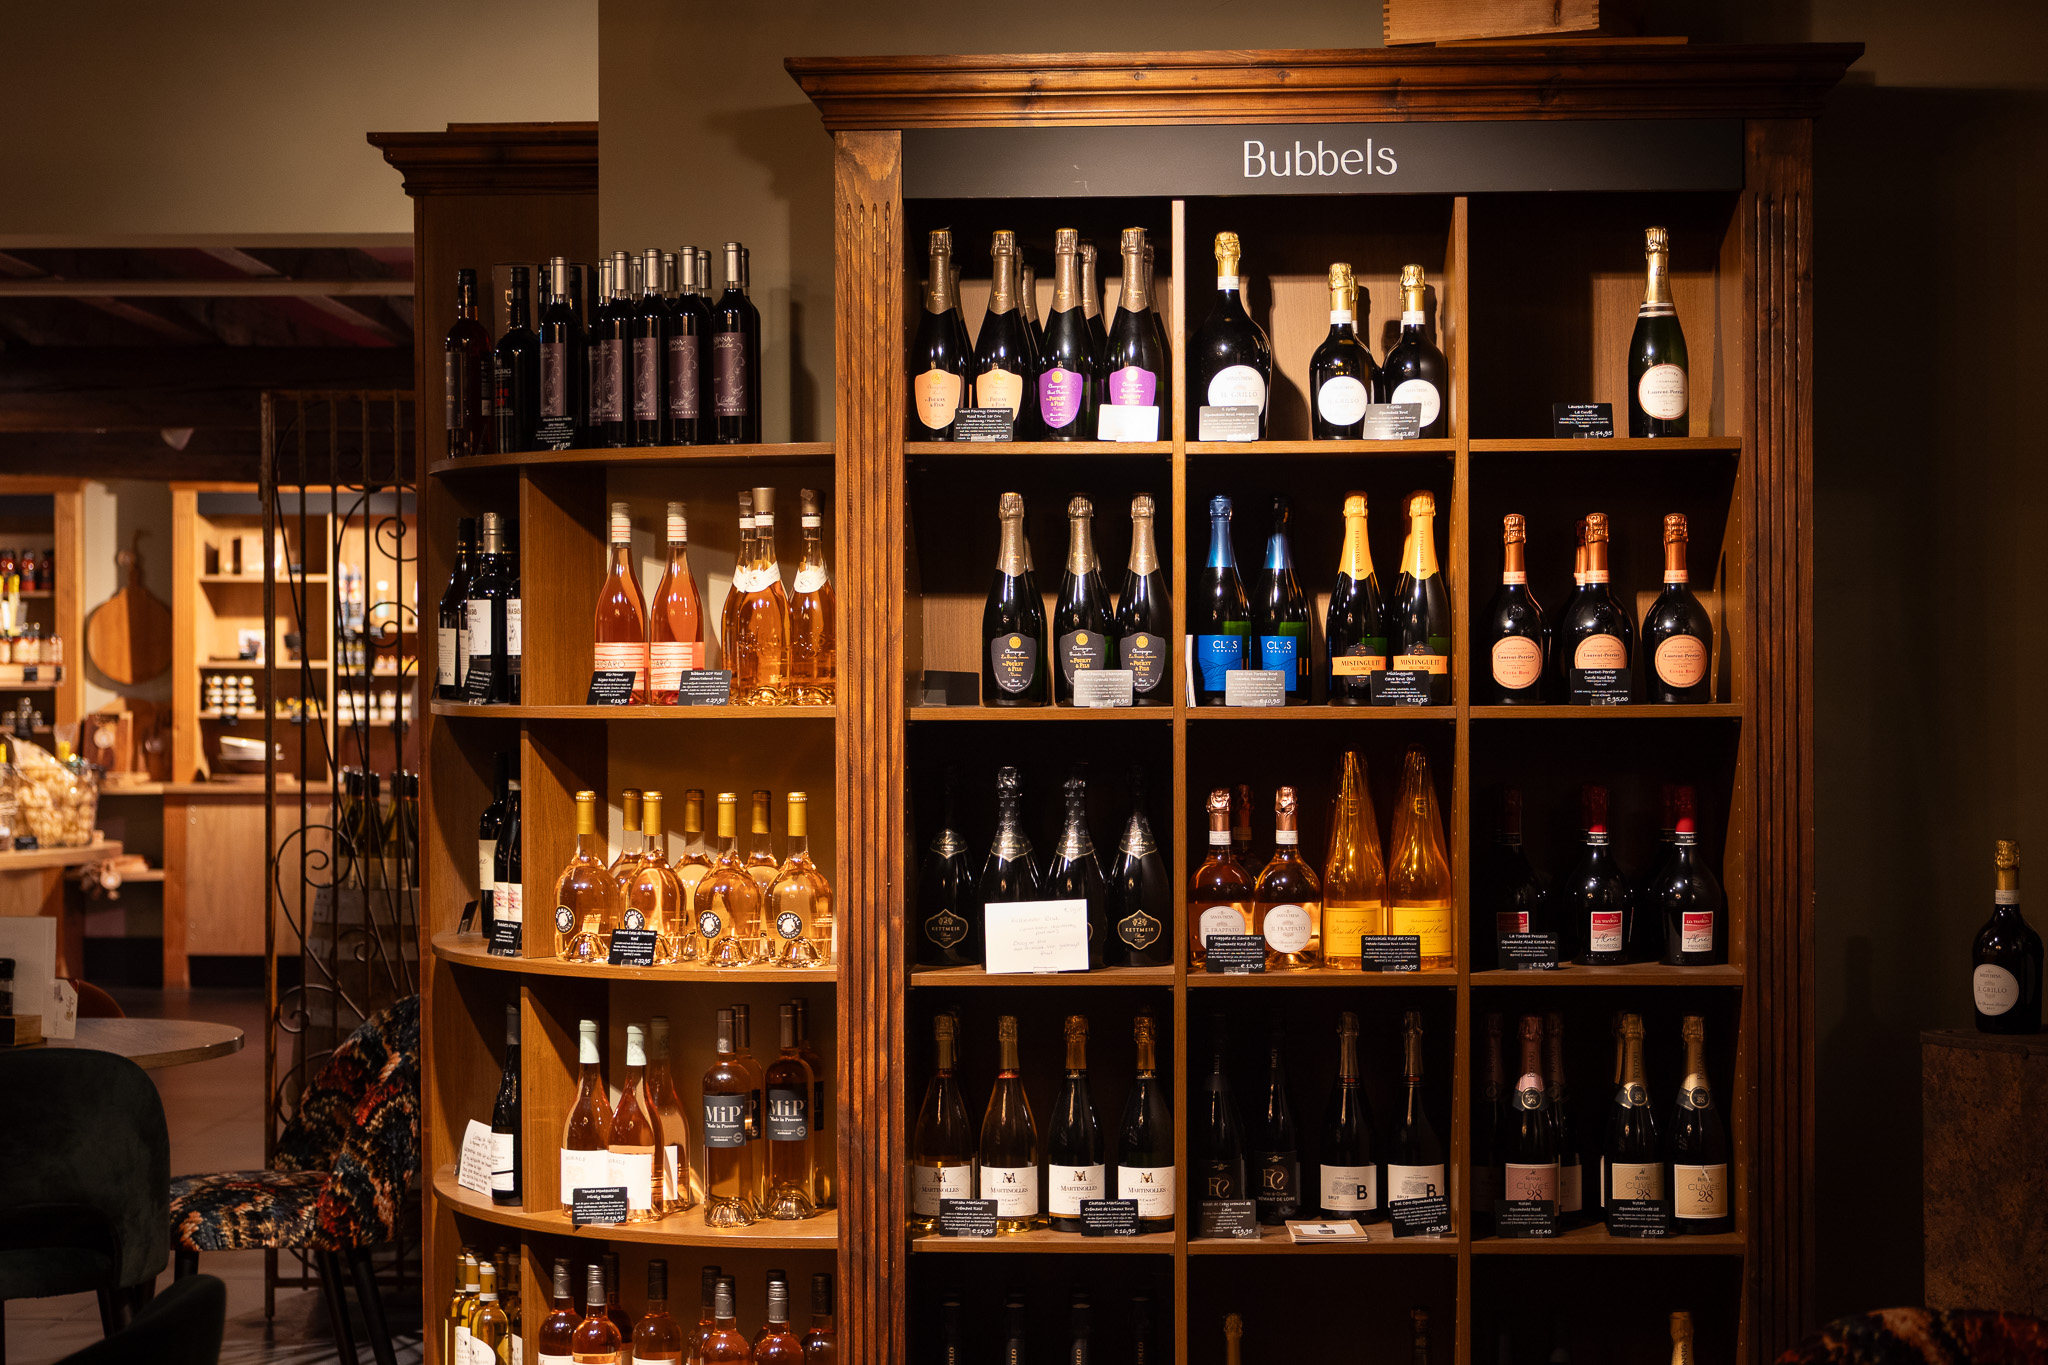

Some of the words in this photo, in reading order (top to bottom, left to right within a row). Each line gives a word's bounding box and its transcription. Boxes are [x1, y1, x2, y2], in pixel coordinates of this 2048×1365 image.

[1243, 138, 1397, 177] Bubbels
[1213, 640, 1238, 649] CLOS
[1266, 641, 1292, 650] CLOS
[624, 909, 643, 923] MIRAVAL
[700, 912, 720, 925] MIRAVAL
[778, 912, 800, 926] MIRAVAL
[779, 928, 800, 938] PROVENCE
[705, 1105, 741, 1122] MiP
[769, 1099, 805, 1116] MiP
[1357, 1185, 1367, 1200] B
[1426, 1184, 1437, 1197] B
[1516, 1182, 1549, 1190] CUVÉE
[1625, 1182, 1658, 1190] CUVÉE
[1688, 1183, 1720, 1191] CUVÉE
[1526, 1189, 1542, 1200] 28
[1636, 1189, 1651, 1200] 28
[1697, 1190, 1713, 1203] 28
